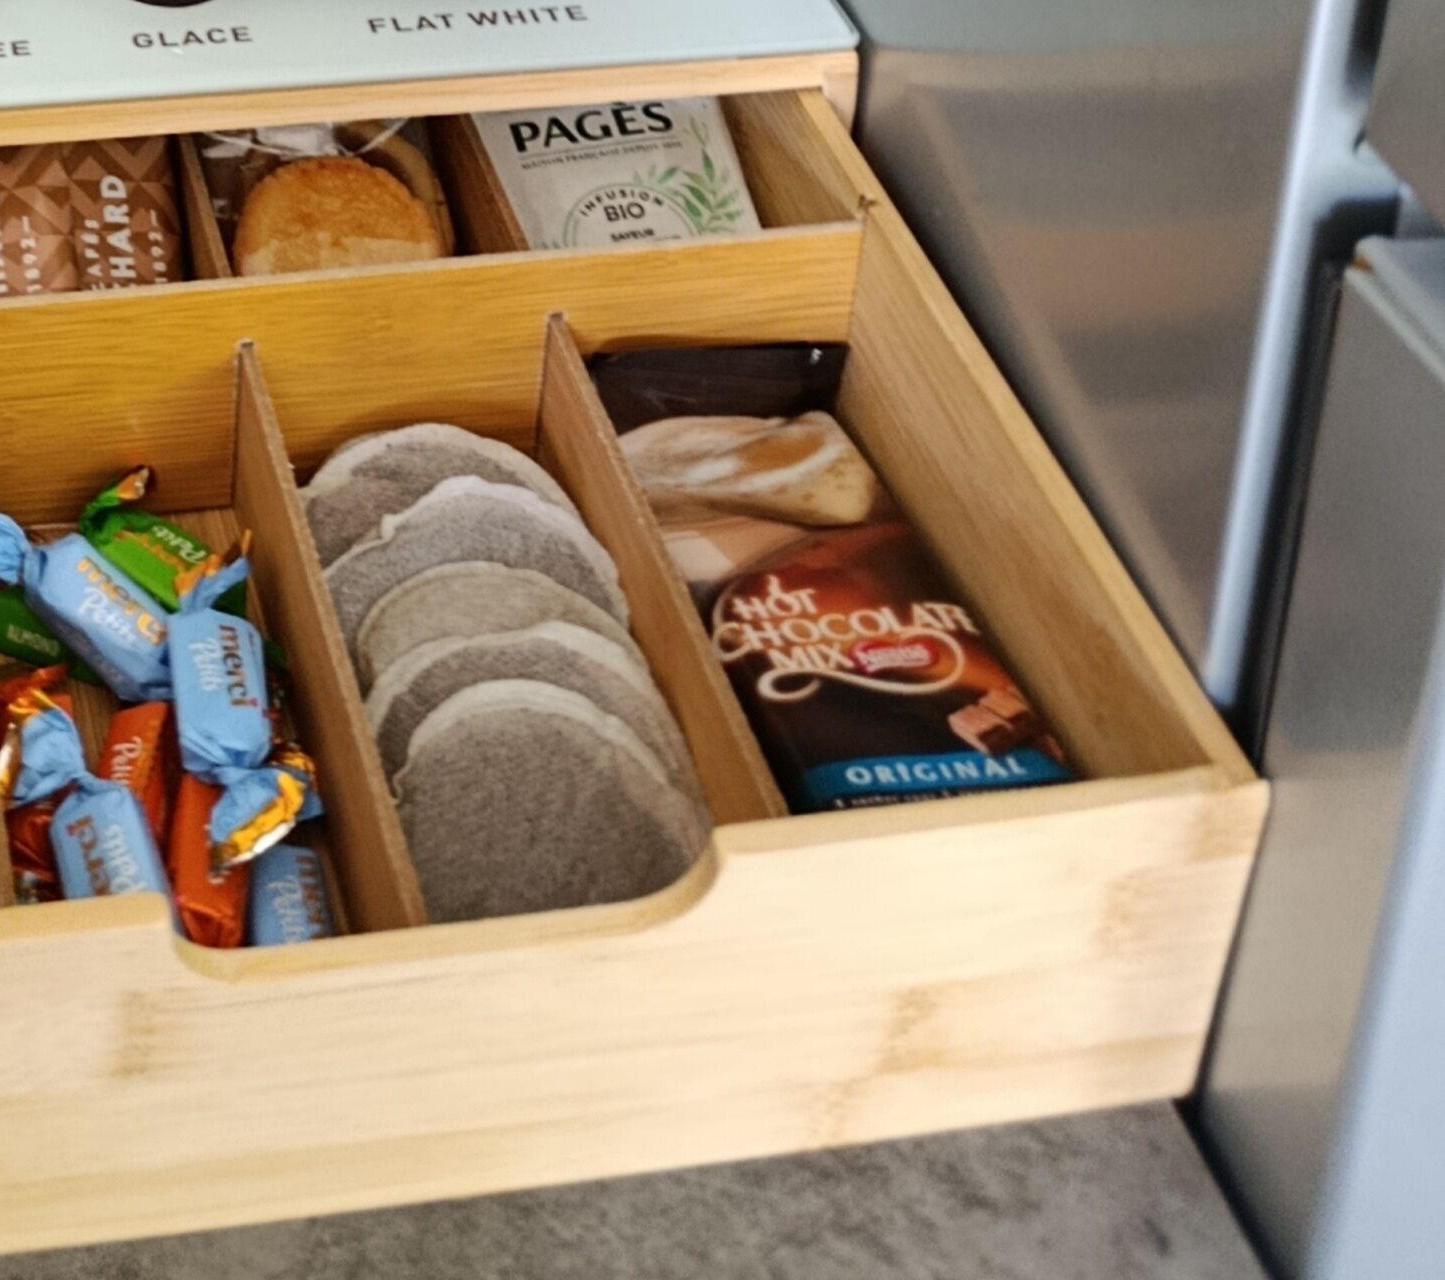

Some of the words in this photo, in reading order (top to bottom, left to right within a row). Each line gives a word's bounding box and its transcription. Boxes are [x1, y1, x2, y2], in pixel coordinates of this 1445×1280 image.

[367, 13, 453, 33] FLAT
[468, 4, 588, 27] WHITE
[132, 26, 253, 48] GLACE
[509, 101, 673, 153] PAGÈS
[579, 190, 664, 218] INFUSION
[604, 203, 645, 223] BIO
[100, 175, 136, 290] HARD
[733, 575, 818, 621] HOT
[218, 624, 260, 707] merci
[768, 643, 855, 670] MIX
[843, 755, 1030, 786] ORIGINAL
